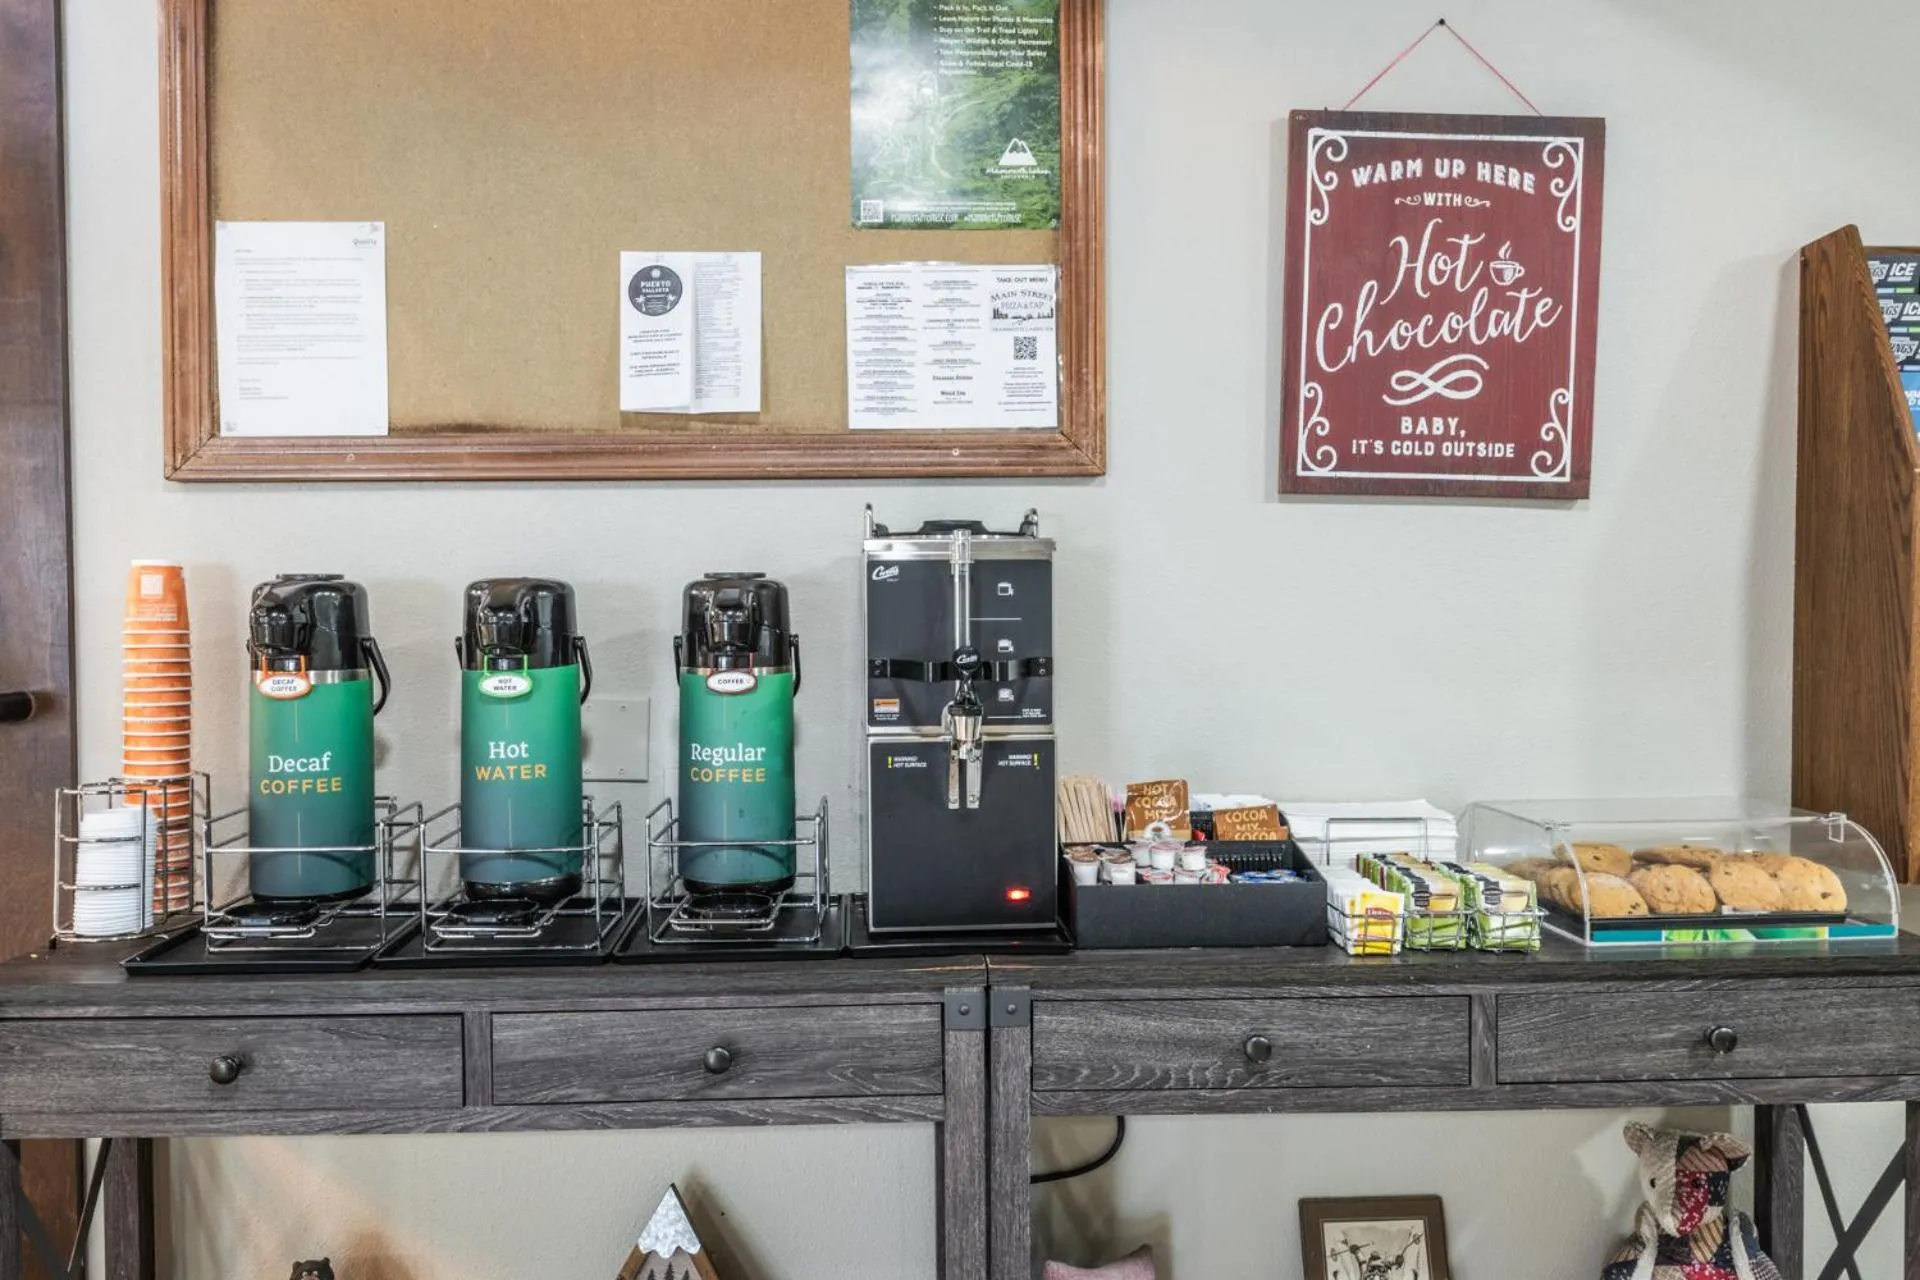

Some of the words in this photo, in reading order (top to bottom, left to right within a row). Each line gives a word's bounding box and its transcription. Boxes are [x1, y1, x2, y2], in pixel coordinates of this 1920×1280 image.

[1352, 158, 1423, 188] WARM
[1434, 158, 1466, 179] UP
[1477, 161, 1537, 195] HERE
[1423, 193, 1462, 208] WITH
[1380, 218, 1486, 306] Hot
[1890, 262, 1917, 276] ICE
[991, 291, 1017, 302] MAIN
[1315, 280, 1564, 373] Chocolate
[1400, 416, 1467, 439] BABY,
[1351, 439, 1384, 455] IT'S
[1391, 440, 1435, 457] COLD
[1442, 442, 1516, 458] OUTSIDE
[488, 741, 529, 759] Hot
[690, 742, 767, 767] Regular
[268, 751, 332, 773] Decaf
[475, 764, 547, 781] WATER
[690, 767, 766, 783] COFFEE
[260, 777, 342, 794] COFFEE
[1143, 784, 1169, 796] HOT
[1134, 796, 1178, 809] COCOA
[1225, 808, 1268, 824] COCOA
